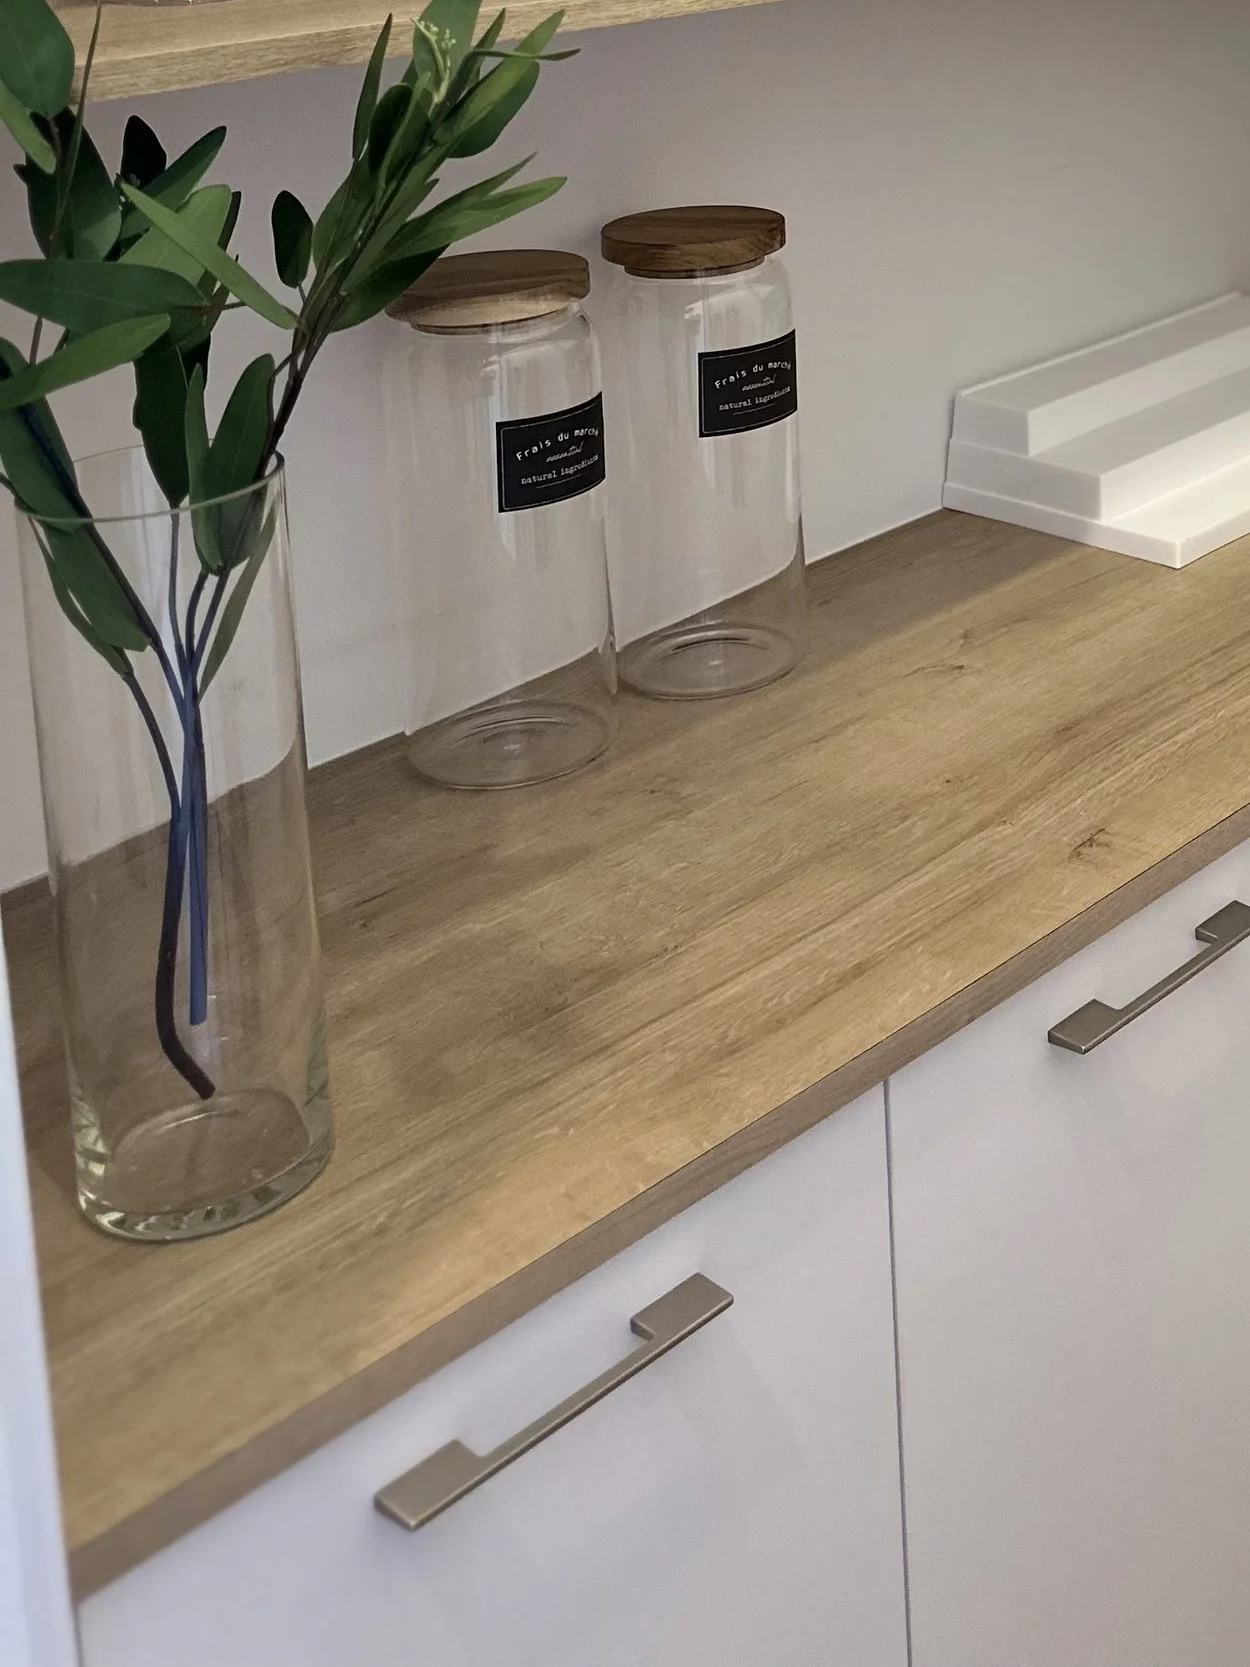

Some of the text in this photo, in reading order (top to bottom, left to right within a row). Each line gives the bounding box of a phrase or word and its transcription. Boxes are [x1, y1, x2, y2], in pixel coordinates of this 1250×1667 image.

[714, 369, 747, 389] Frais
[752, 364, 764, 373] du
[718, 398, 753, 412] natural
[515, 439, 552, 461] Frais
[557, 431, 570, 442] du
[520, 469, 557, 485] natural
